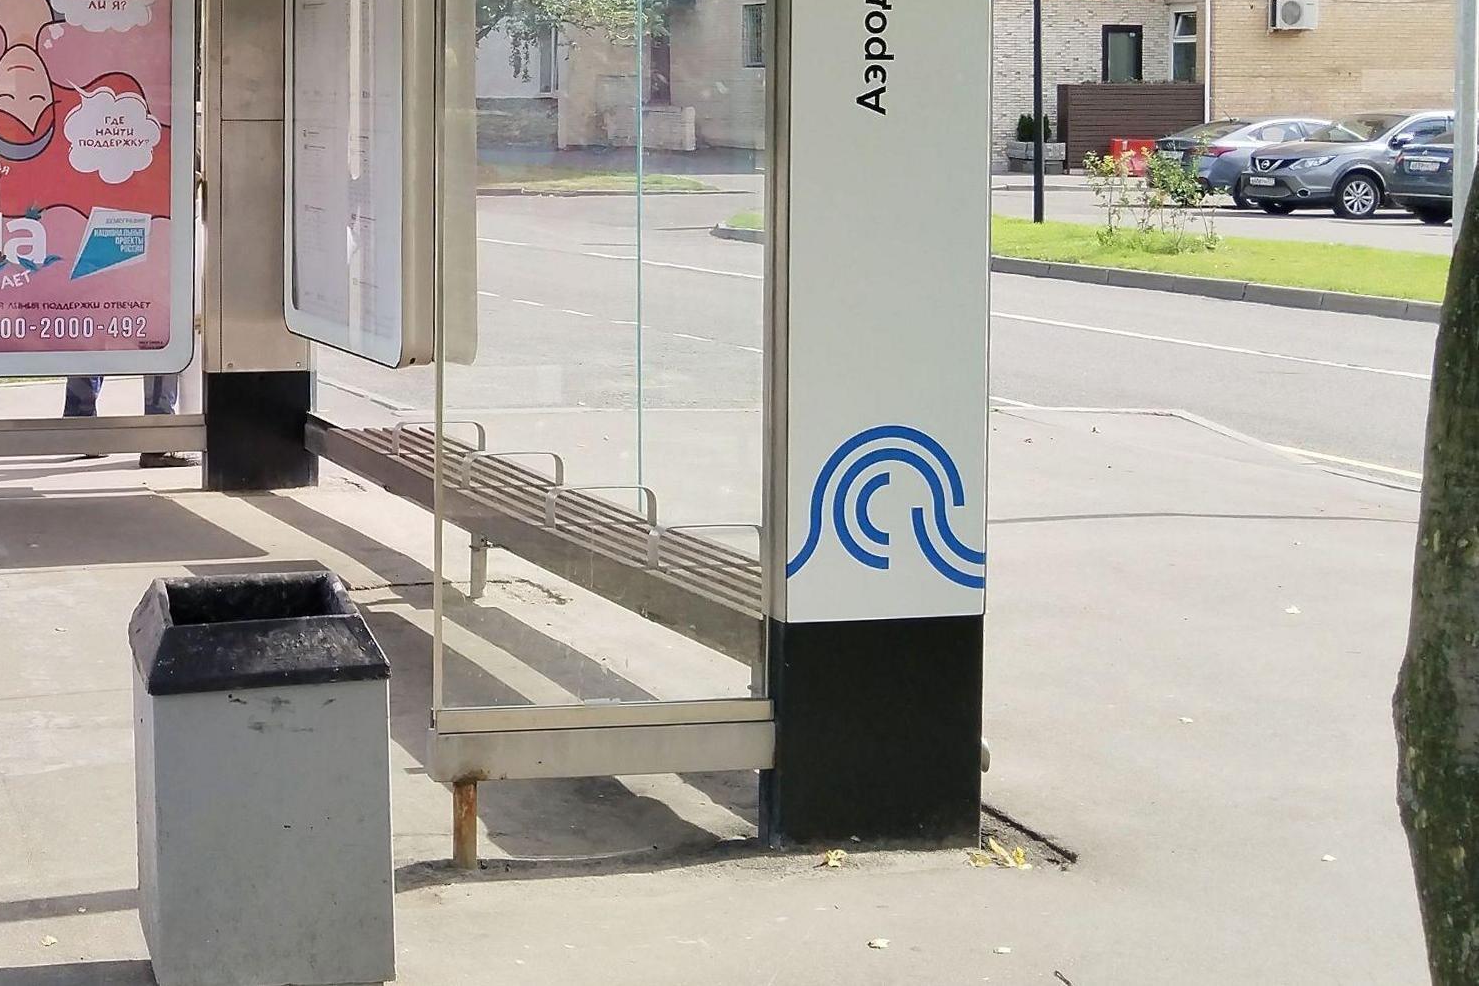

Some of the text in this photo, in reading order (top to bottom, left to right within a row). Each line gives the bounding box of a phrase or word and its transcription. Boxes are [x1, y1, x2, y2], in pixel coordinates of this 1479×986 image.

[88, 0, 127, 10] ЛИ Я?
[104, 116, 125, 126] ГДЕ
[95, 126, 134, 136] НАЙТИ
[78, 139, 149, 148] ПОДДЕРЖКУ?
[42, 301, 100, 311] ПОДДЕРЖКИ
[103, 301, 151, 310] ОТВЕЧАЕТ
